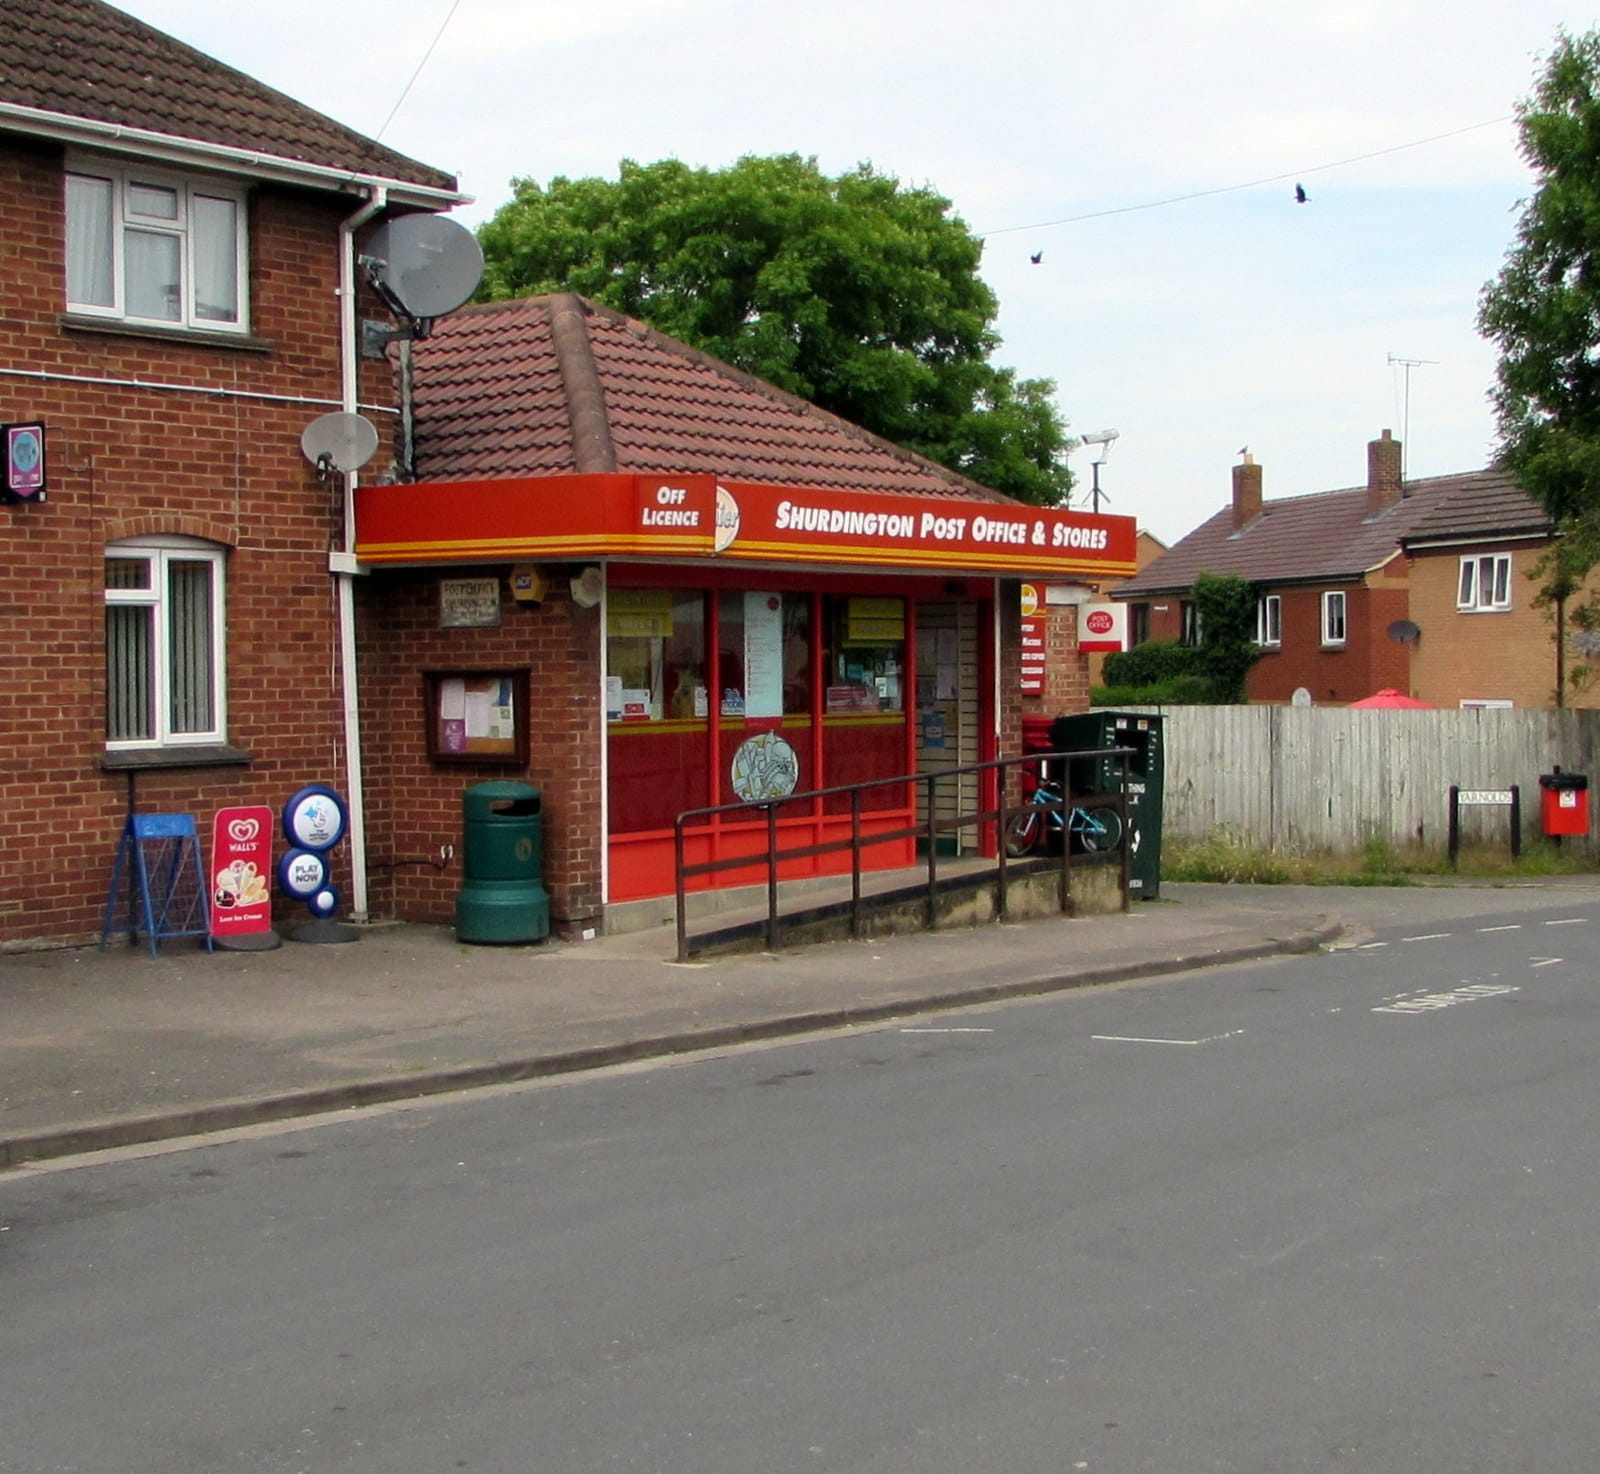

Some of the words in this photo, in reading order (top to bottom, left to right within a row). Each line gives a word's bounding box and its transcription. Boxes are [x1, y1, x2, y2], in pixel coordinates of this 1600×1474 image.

[657, 486, 686, 505] OFF
[642, 507, 700, 527] LICENCE
[775, 501, 914, 539] SHURDINGTON
[920, 512, 966, 541] POST
[972, 516, 1027, 545] OFFICE
[1031, 520, 1046, 546] &
[1052, 522, 1108, 549] STORES
[1088, 621, 1111, 629] OFFICE
[295, 864, 318, 874] PLAY
[295, 873, 318, 883] NOW
